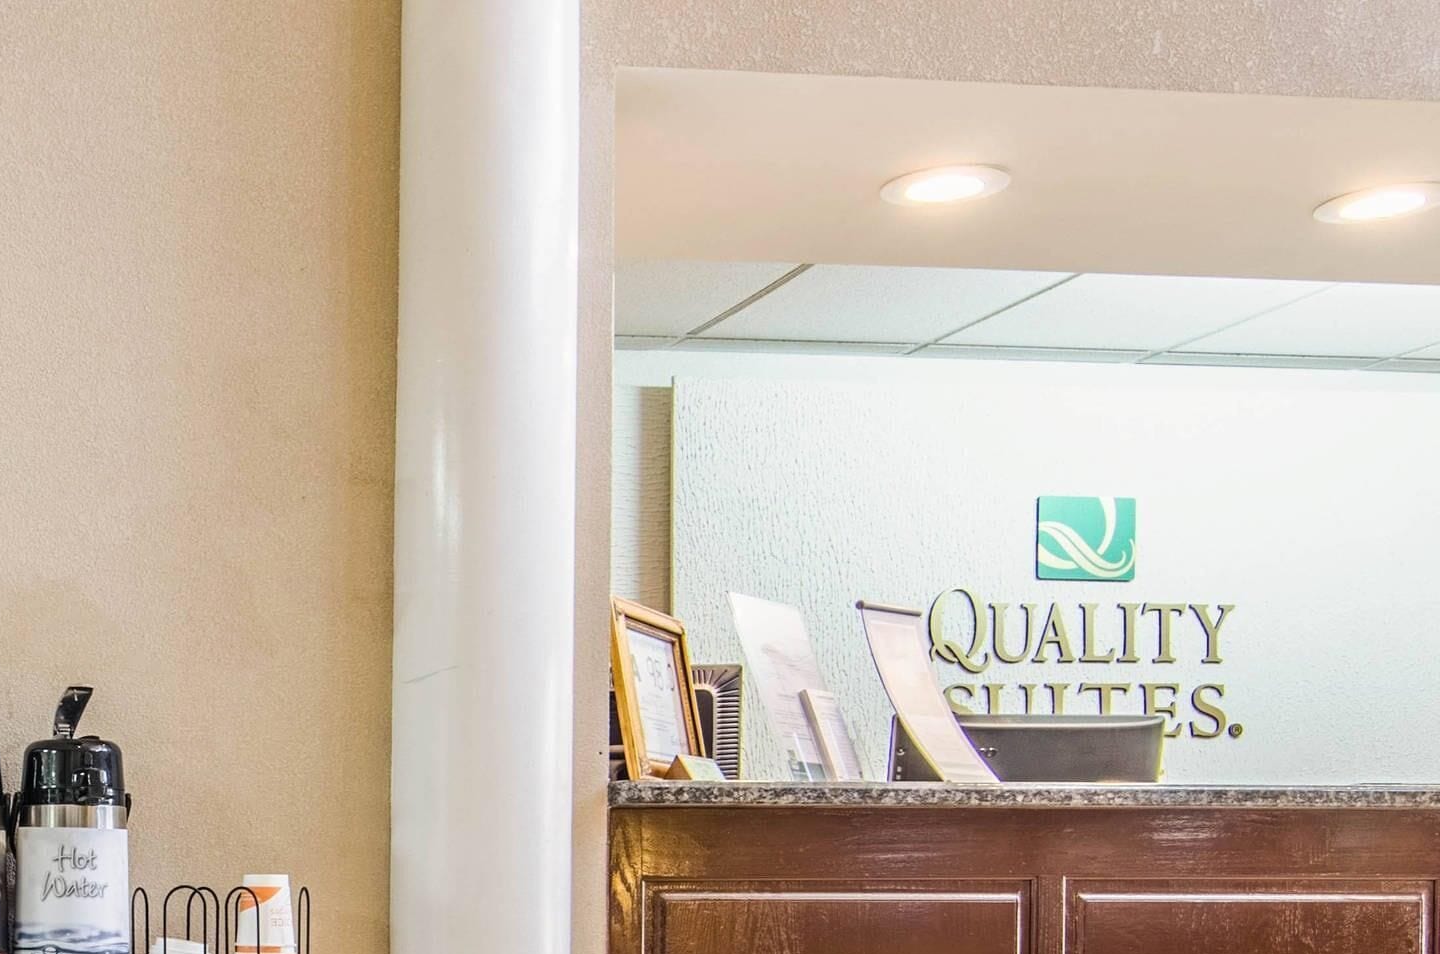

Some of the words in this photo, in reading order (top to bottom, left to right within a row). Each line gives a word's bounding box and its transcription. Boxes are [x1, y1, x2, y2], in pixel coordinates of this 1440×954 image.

[928, 588, 1236, 674] QUALITY
[52, 844, 98, 872] Hot
[40, 872, 109, 902] Water
